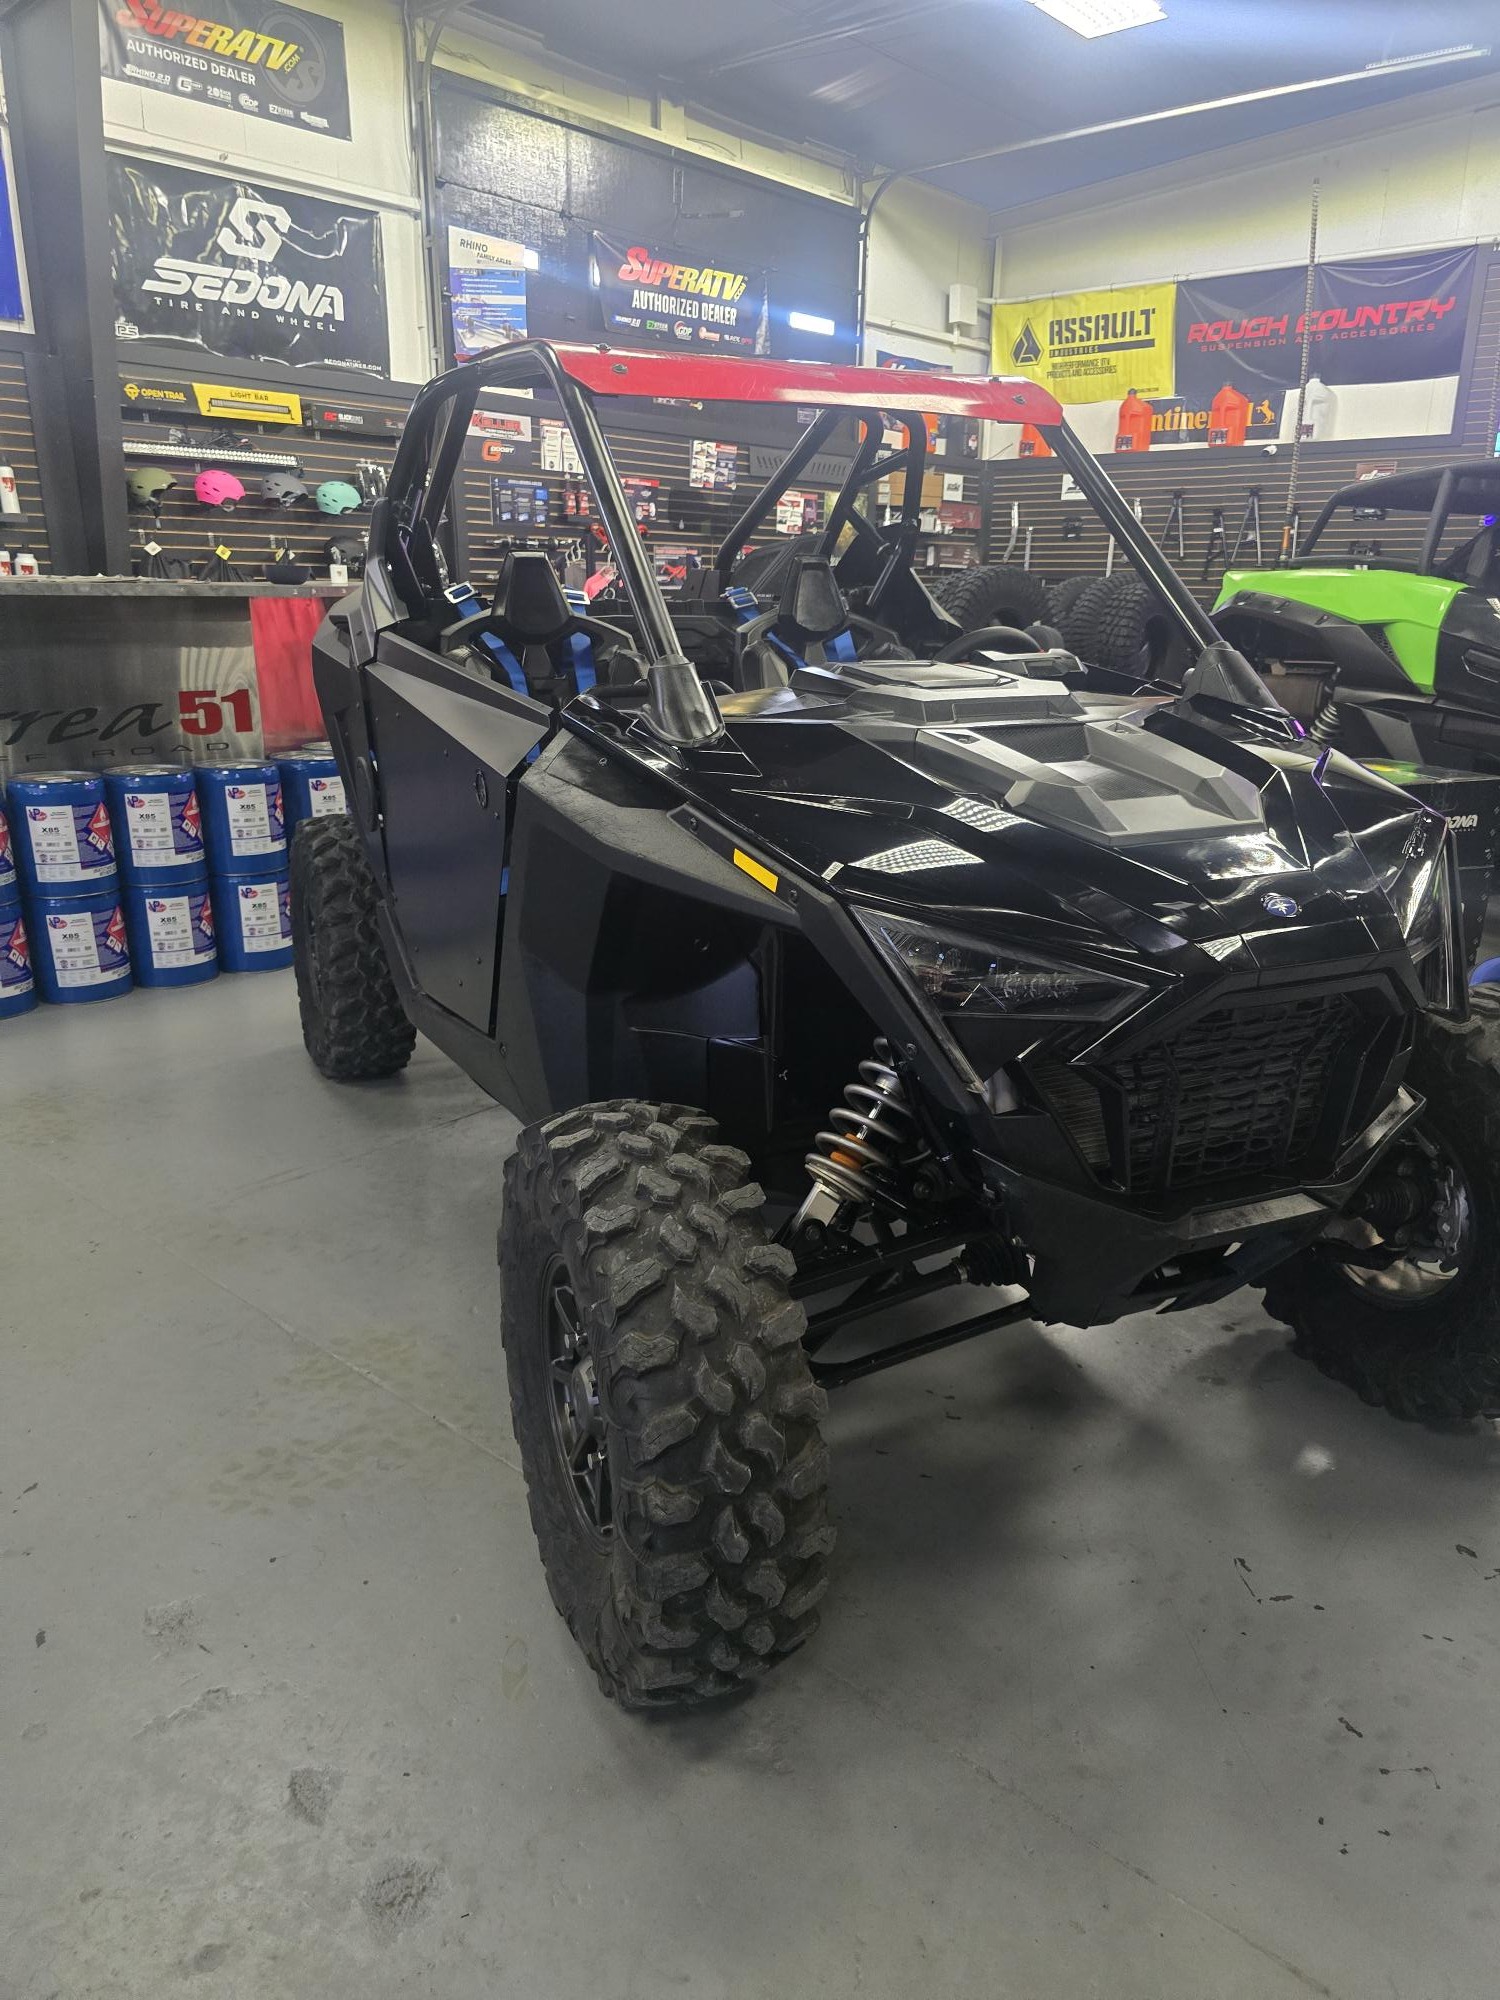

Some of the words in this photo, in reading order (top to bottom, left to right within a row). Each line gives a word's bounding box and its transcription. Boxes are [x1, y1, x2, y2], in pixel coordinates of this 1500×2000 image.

[126, 39, 207, 71] AUTHORIZED
[211, 62, 256, 86] DEALER
[460, 238, 488, 253] RHINO
[476, 252, 495, 262] FAMILY
[141, 257, 345, 322] SEDONA
[618, 246, 744, 301] SUPERATV
[153, 297, 204, 312] TIRE
[221, 308, 260, 321] AND
[276, 315, 337, 333] WHEEL
[631, 289, 699, 319] AUTHORIZED
[702, 303, 738, 327] DEALER
[1187, 314, 1290, 344] ROUGH
[1295, 296, 1456, 334] COUNTRY
[1049, 308, 1156, 346] ASSAULT
[1199, 338, 1287, 352] SUSPENSION
[1331, 322, 1437, 340] ACCESSORIES
[141, 388, 164, 399] OPEN
[164, 390, 187, 401] TRAIL
[230, 391, 252, 400] LIGHT
[178, 688, 254, 736] 51
[92, 742, 229, 759] ROAD
